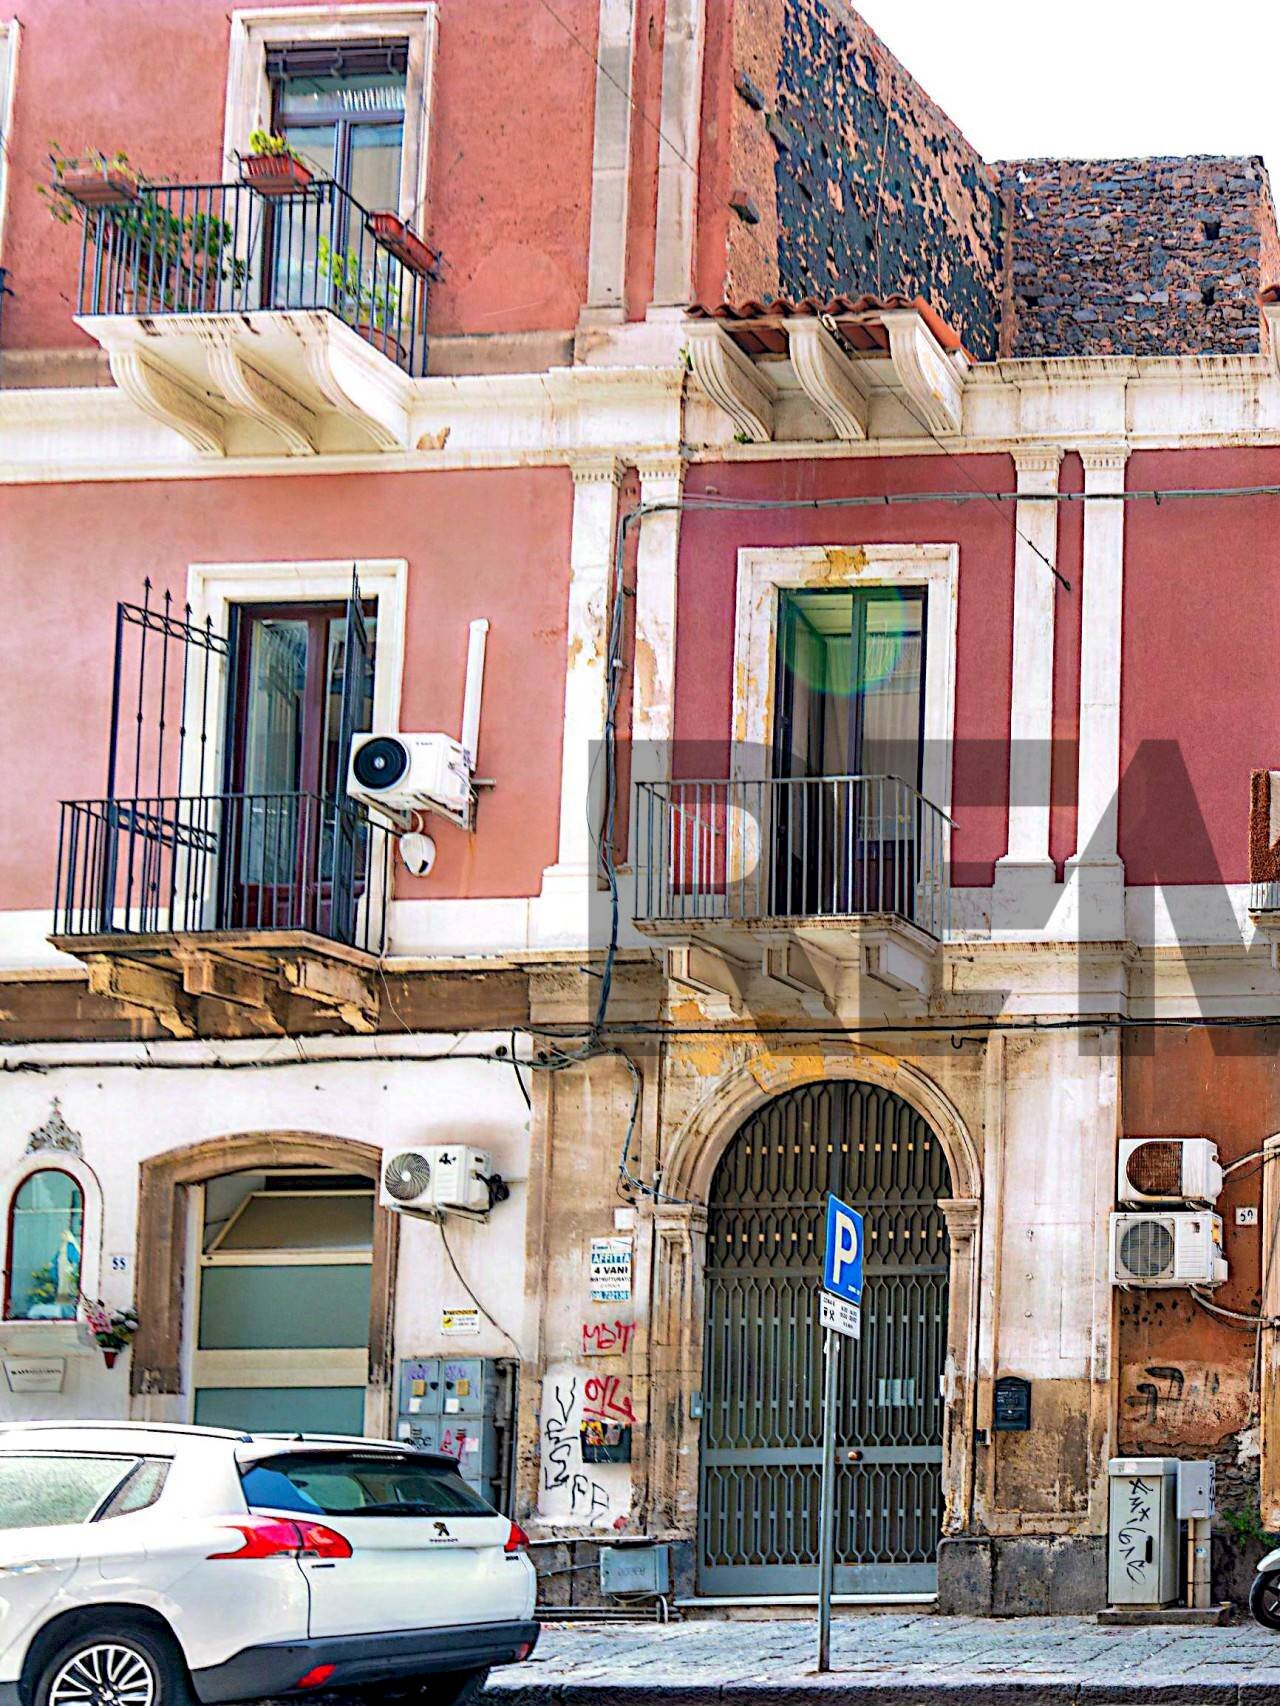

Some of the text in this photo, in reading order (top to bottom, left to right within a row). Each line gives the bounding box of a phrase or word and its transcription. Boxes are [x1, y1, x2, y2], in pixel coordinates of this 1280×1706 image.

[833, 1210, 858, 1285] P
[594, 1266, 629, 1275] 4 VANI
